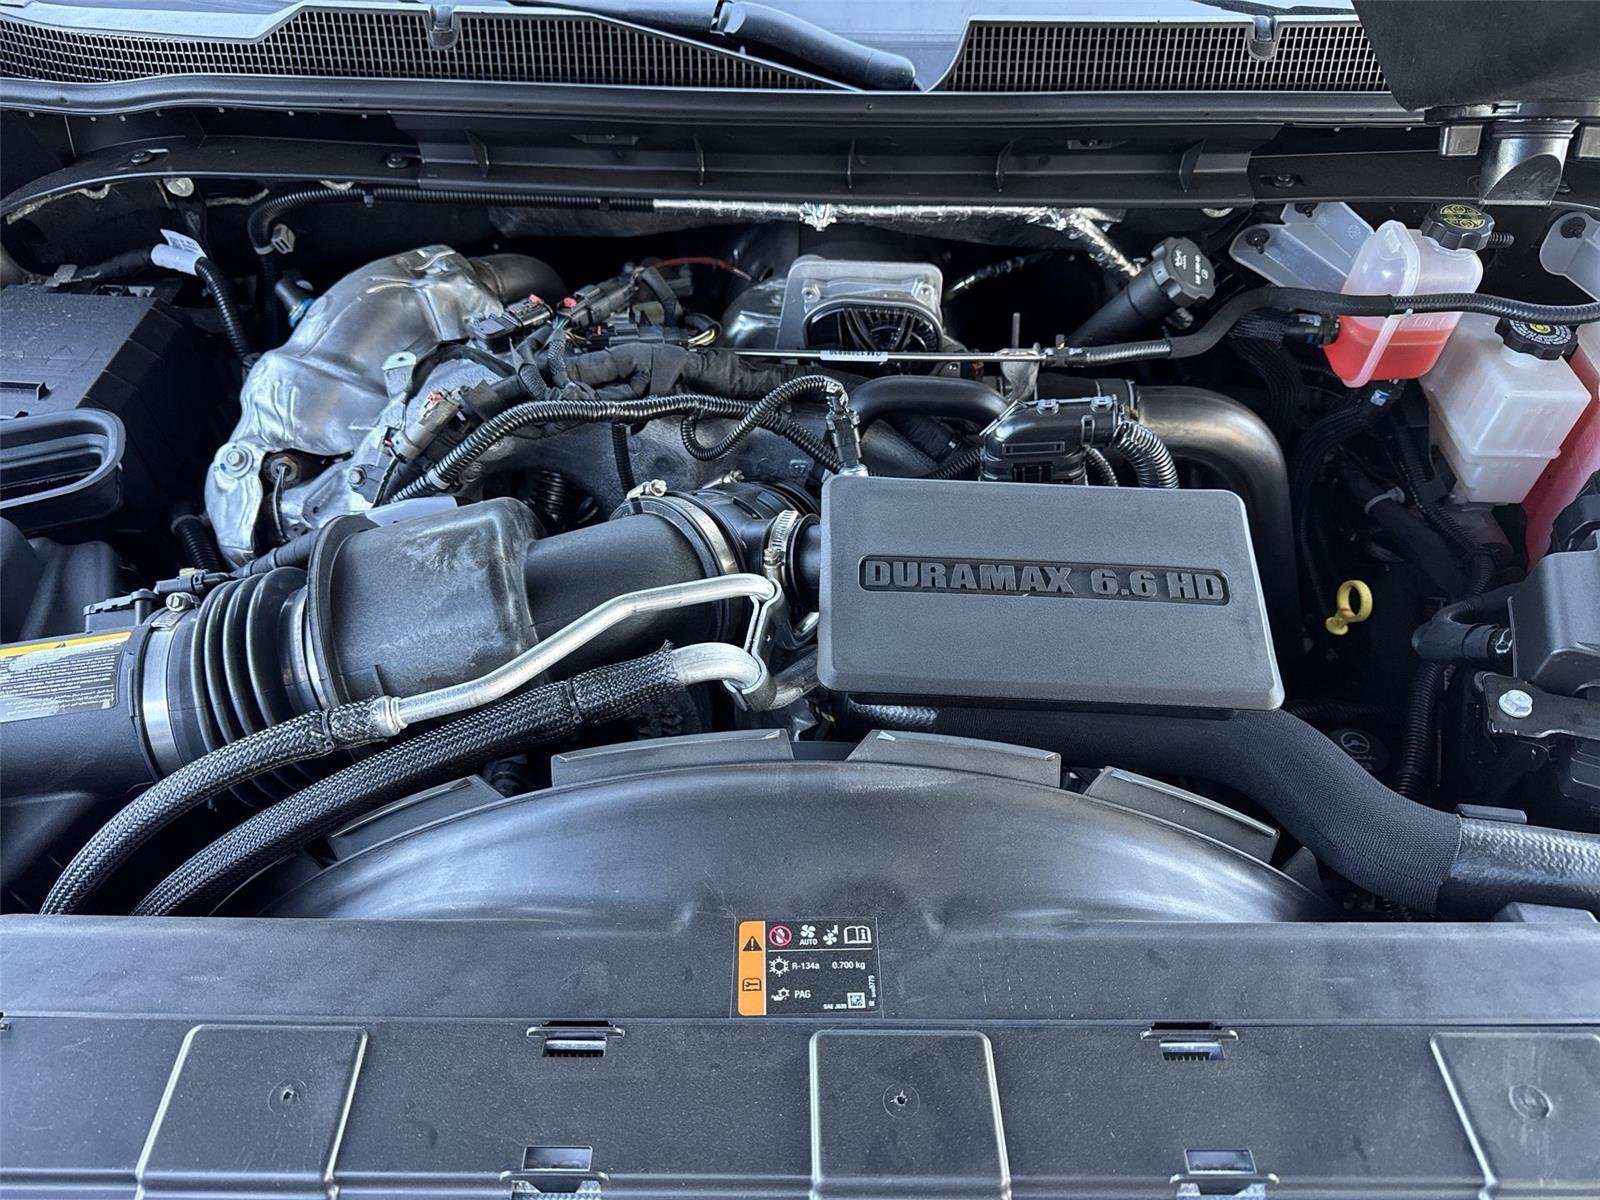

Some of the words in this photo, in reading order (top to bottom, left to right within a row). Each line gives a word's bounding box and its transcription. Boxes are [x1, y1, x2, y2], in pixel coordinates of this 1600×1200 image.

[865, 560, 1075, 594] DURAMAX
[1090, 568, 1158, 598] 6.6
[1165, 571, 1224, 600] HD
[799, 938, 818, 946] AUTO
[791, 961, 820, 970] R-134a
[831, 961, 854, 970] 0.700
[855, 961, 866, 971] kg
[794, 989, 811, 999] PAG
